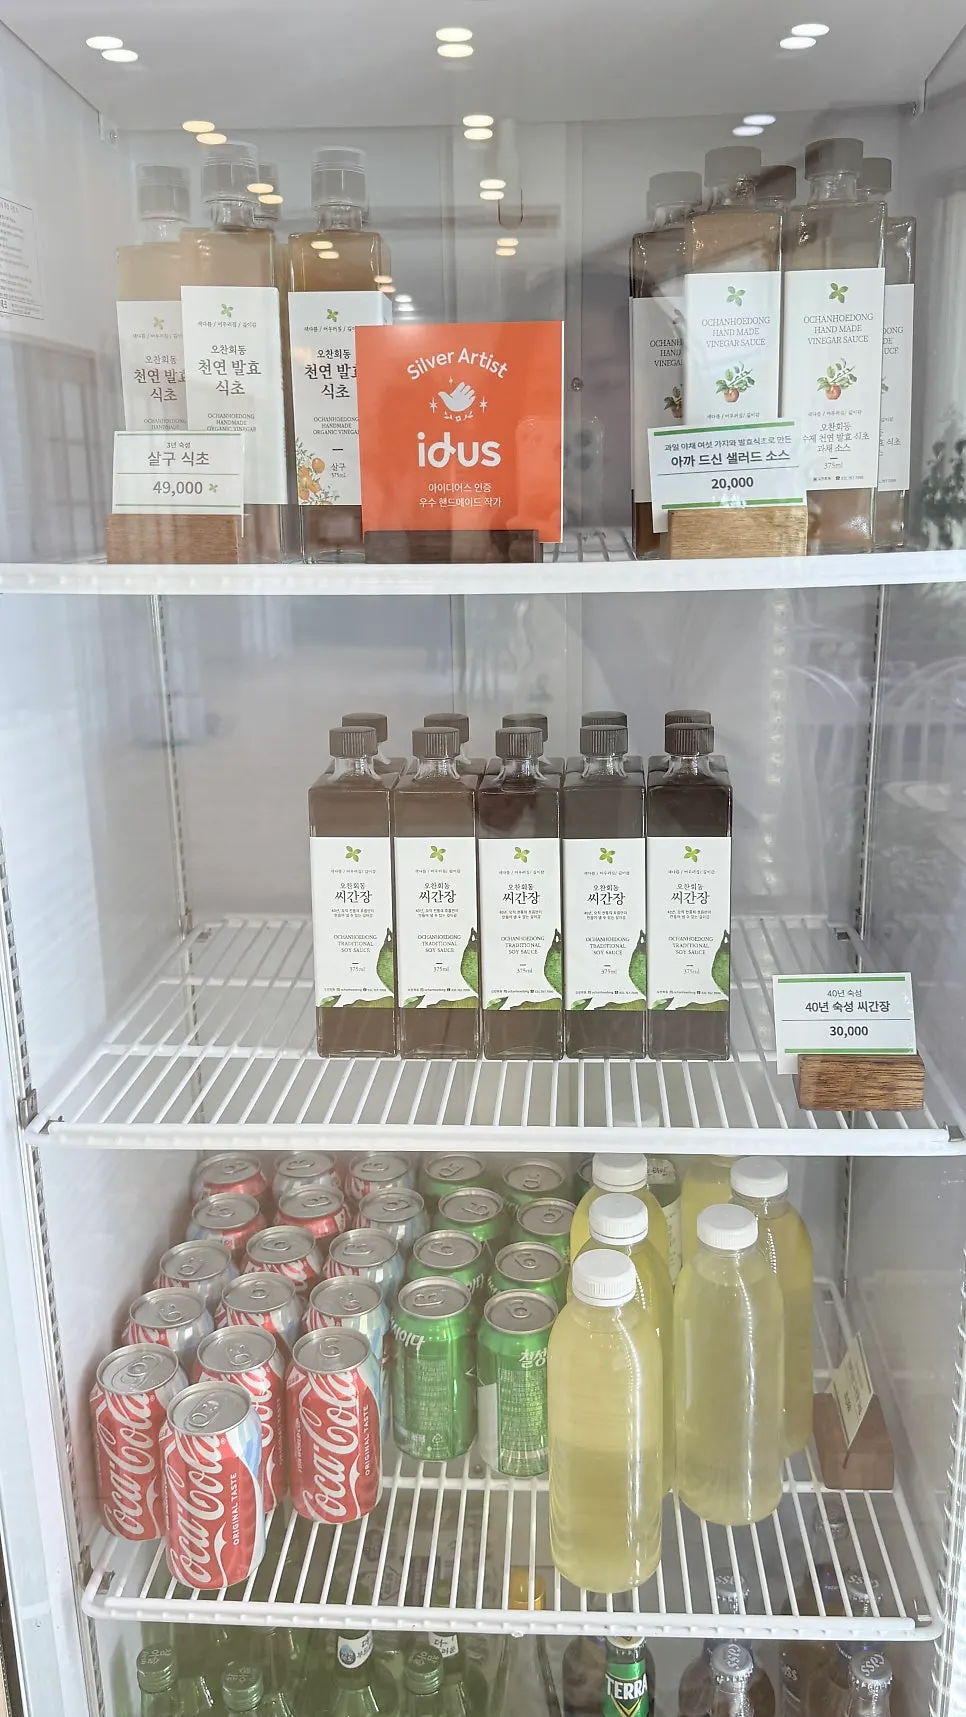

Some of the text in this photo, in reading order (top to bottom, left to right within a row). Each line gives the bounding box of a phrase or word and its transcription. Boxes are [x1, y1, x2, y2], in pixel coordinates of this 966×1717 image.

[702, 316, 770, 326] OCHANHOEDONG
[804, 313, 874, 324] OCHANHOEDONG
[712, 328, 760, 336] HAND MADE
[814, 324, 862, 334] HAND MADE
[706, 338, 766, 348] VINEGAR SAUCE
[808, 336, 868, 344] VINEGAR SAUCE
[210, 344, 246, 354] 오찬회동
[317, 350, 351, 360] 오찬회동
[145, 355, 176, 364] 오찬회동
[407, 348, 508, 380] Silver Artist
[198, 360, 262, 376] 천연 발효
[305, 364, 332, 380] 천연
[134, 369, 160, 384] 천연
[150, 388, 178, 402] 식초
[215, 380, 246, 396] 식초
[322, 384, 350, 400] 식초
[820, 423, 851, 432] 오찬회동
[664, 436, 792, 452] 과일 야채 여섯 가지와 발효식초로 만든
[819, 434, 834, 442] 천연
[836, 432, 852, 442] 발효
[854, 432, 870, 440] 식초
[417, 432, 502, 468] idus
[818, 444, 851, 453] 과채 소스
[148, 452, 210, 466] 살구 식초
[671, 450, 790, 468] 아까 드신 샐러드 소스
[332, 463, 346, 471] 살구
[153, 480, 203, 496] 49,000
[428, 483, 492, 494] 아이디어스 인증
[712, 476, 754, 490] 20,000
[419, 497, 502, 508] 우수 핸드메이드 작가
[335, 890, 372, 904] 씨간장
[419, 890, 456, 904] 씨간장
[502, 891, 540, 905] 씨간장
[588, 892, 626, 906] 씨간장
[671, 891, 710, 905] 씨간장
[805, 1001, 890, 1012] 40년 숙성 씨간장
[830, 1026, 868, 1038] 30,000
[300, 1371, 359, 1523] Coca-Cola
[166, 1434, 226, 1589] Coca-Cola
[233, 1500, 241, 1546] ORIGINAL
[606, 1673, 648, 1700] TERRA
